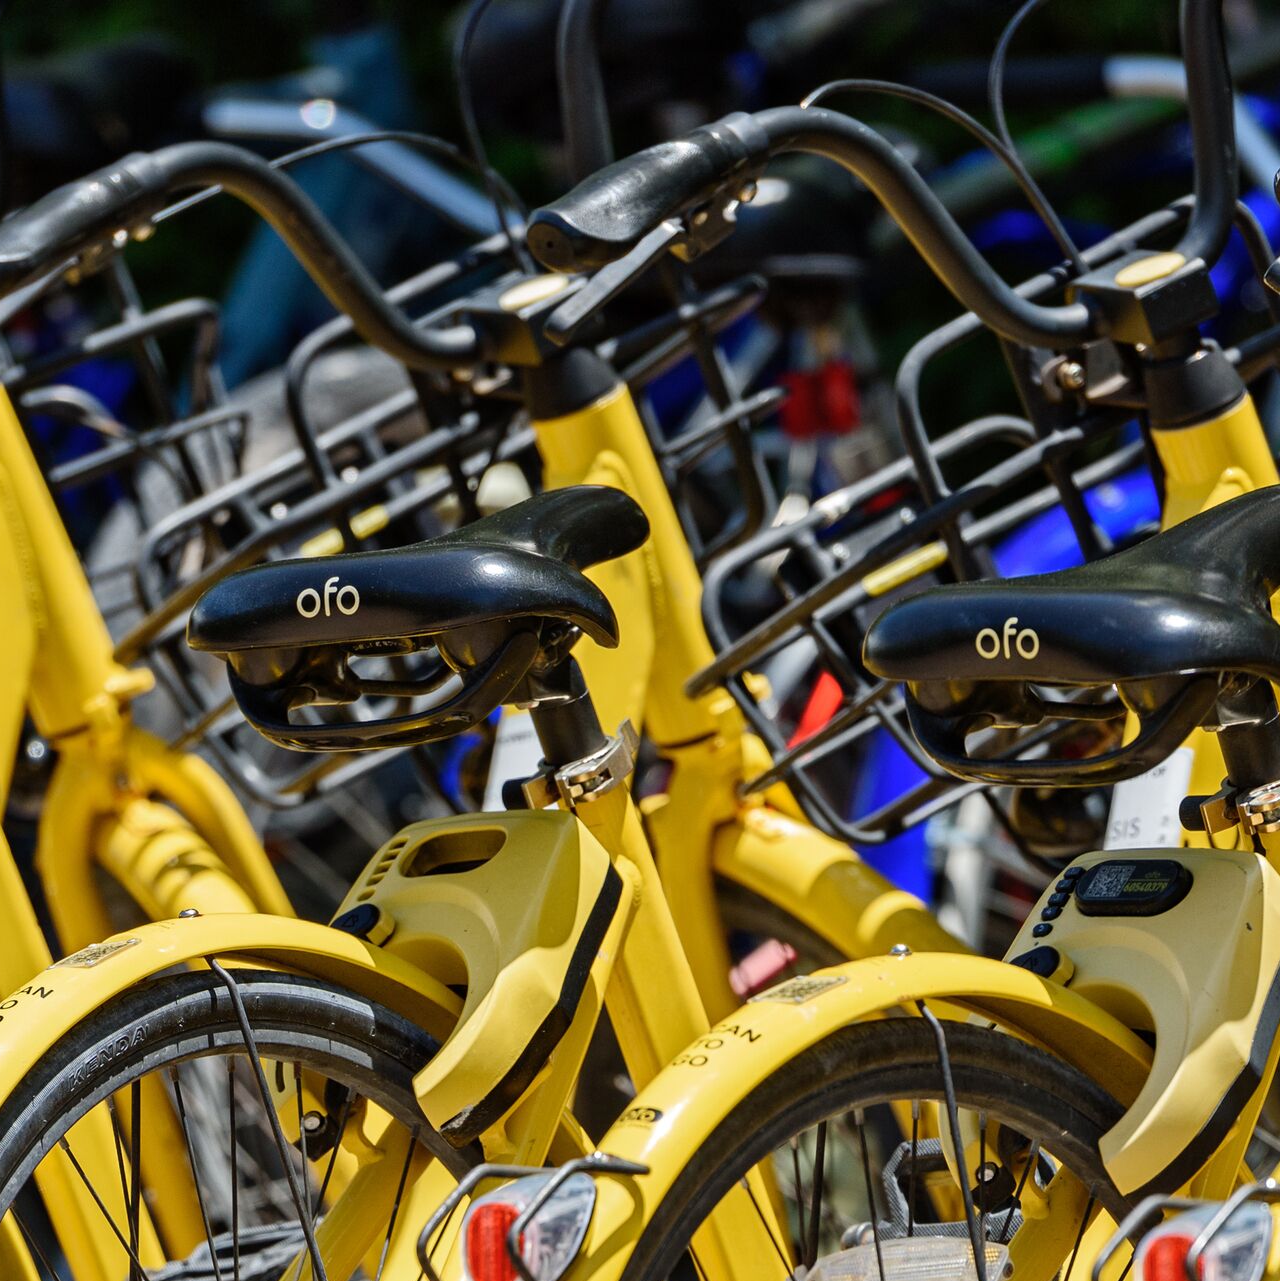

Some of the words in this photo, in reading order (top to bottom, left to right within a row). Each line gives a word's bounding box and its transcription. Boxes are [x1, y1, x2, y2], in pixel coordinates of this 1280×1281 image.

[296, 576, 361, 619] ofo
[975, 616, 1040, 660] ofo
[69, 1026, 144, 1091] KENDA
